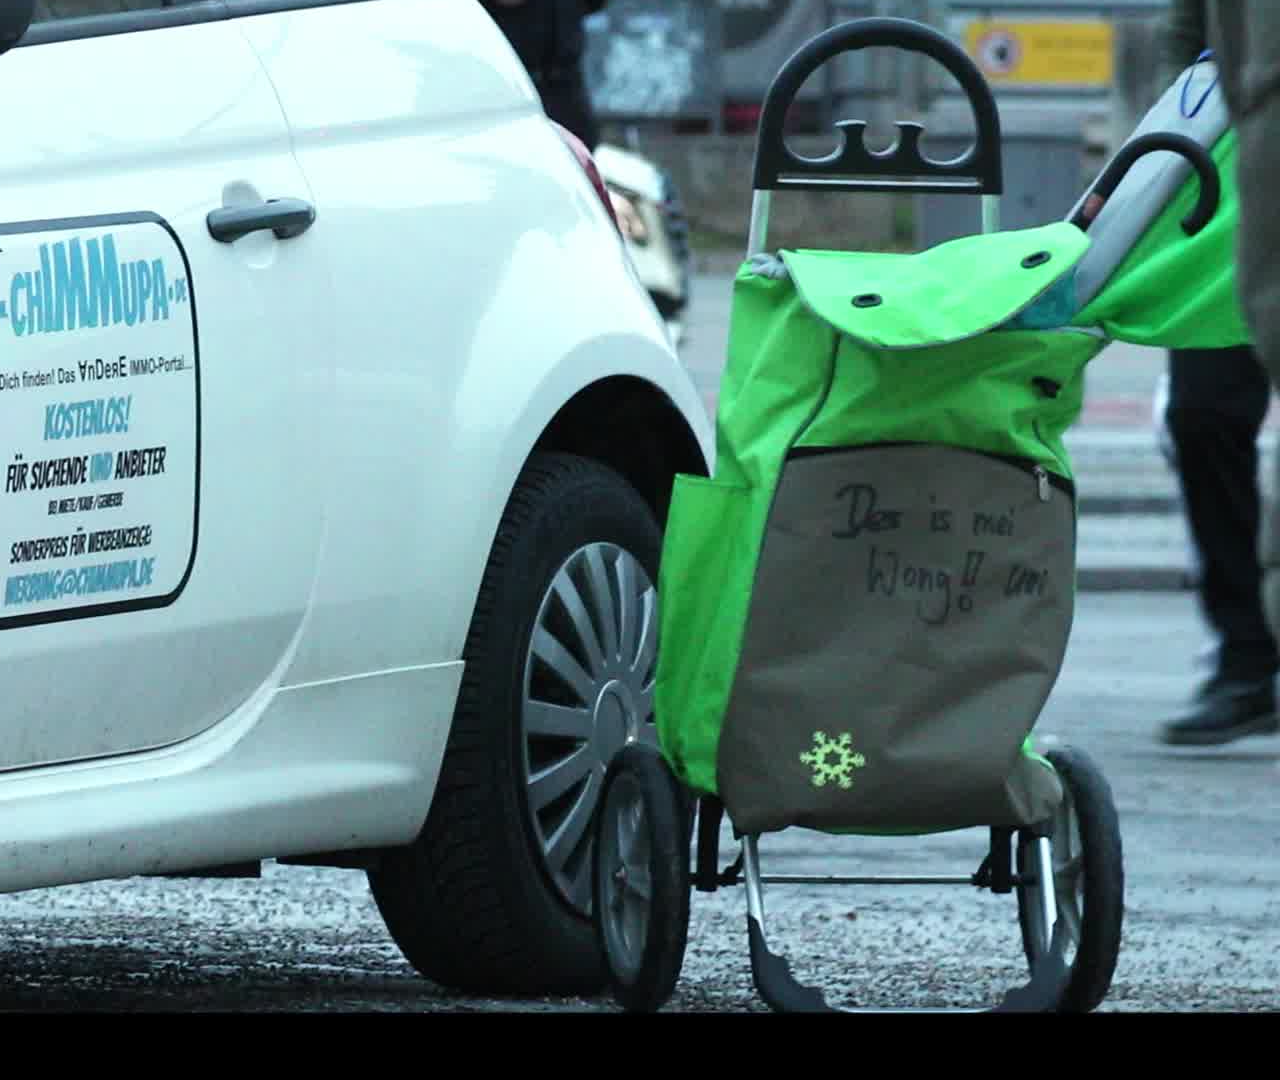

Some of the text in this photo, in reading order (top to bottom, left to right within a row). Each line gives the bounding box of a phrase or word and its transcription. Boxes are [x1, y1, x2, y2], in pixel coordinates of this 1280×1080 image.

[22, 366, 55, 388] finden!
[58, 366, 76, 384] Das
[43, 395, 132, 441] KOSTENLOS!
[6, 446, 167, 494] FÜR SUCHENDE UND ANBIETER
[929, 494, 953, 533] is
[972, 507, 1015, 537] mei
[10, 535, 69, 565] SONDERPREIS
[69, 526, 88, 556] FÜR
